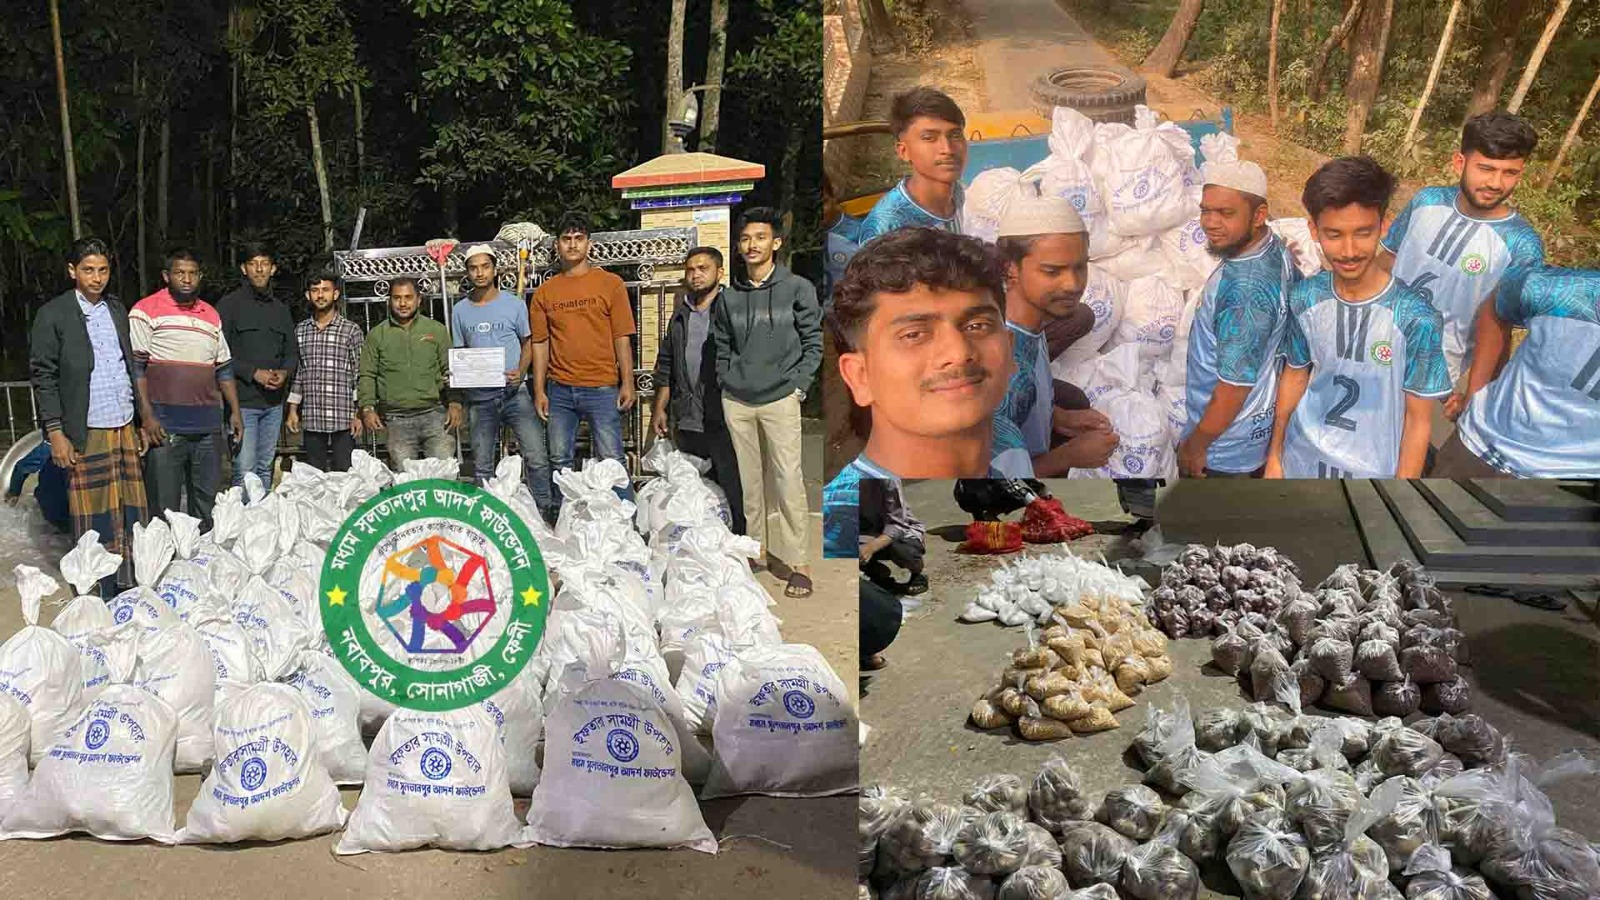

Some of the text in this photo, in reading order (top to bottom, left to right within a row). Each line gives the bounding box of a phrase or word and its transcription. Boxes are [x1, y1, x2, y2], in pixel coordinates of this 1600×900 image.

[1324, 374, 1361, 432] 2
[454, 740, 483, 773] উপহার
[606, 713, 641, 732] সামগ্রী
[643, 719, 674, 757] উপহার
